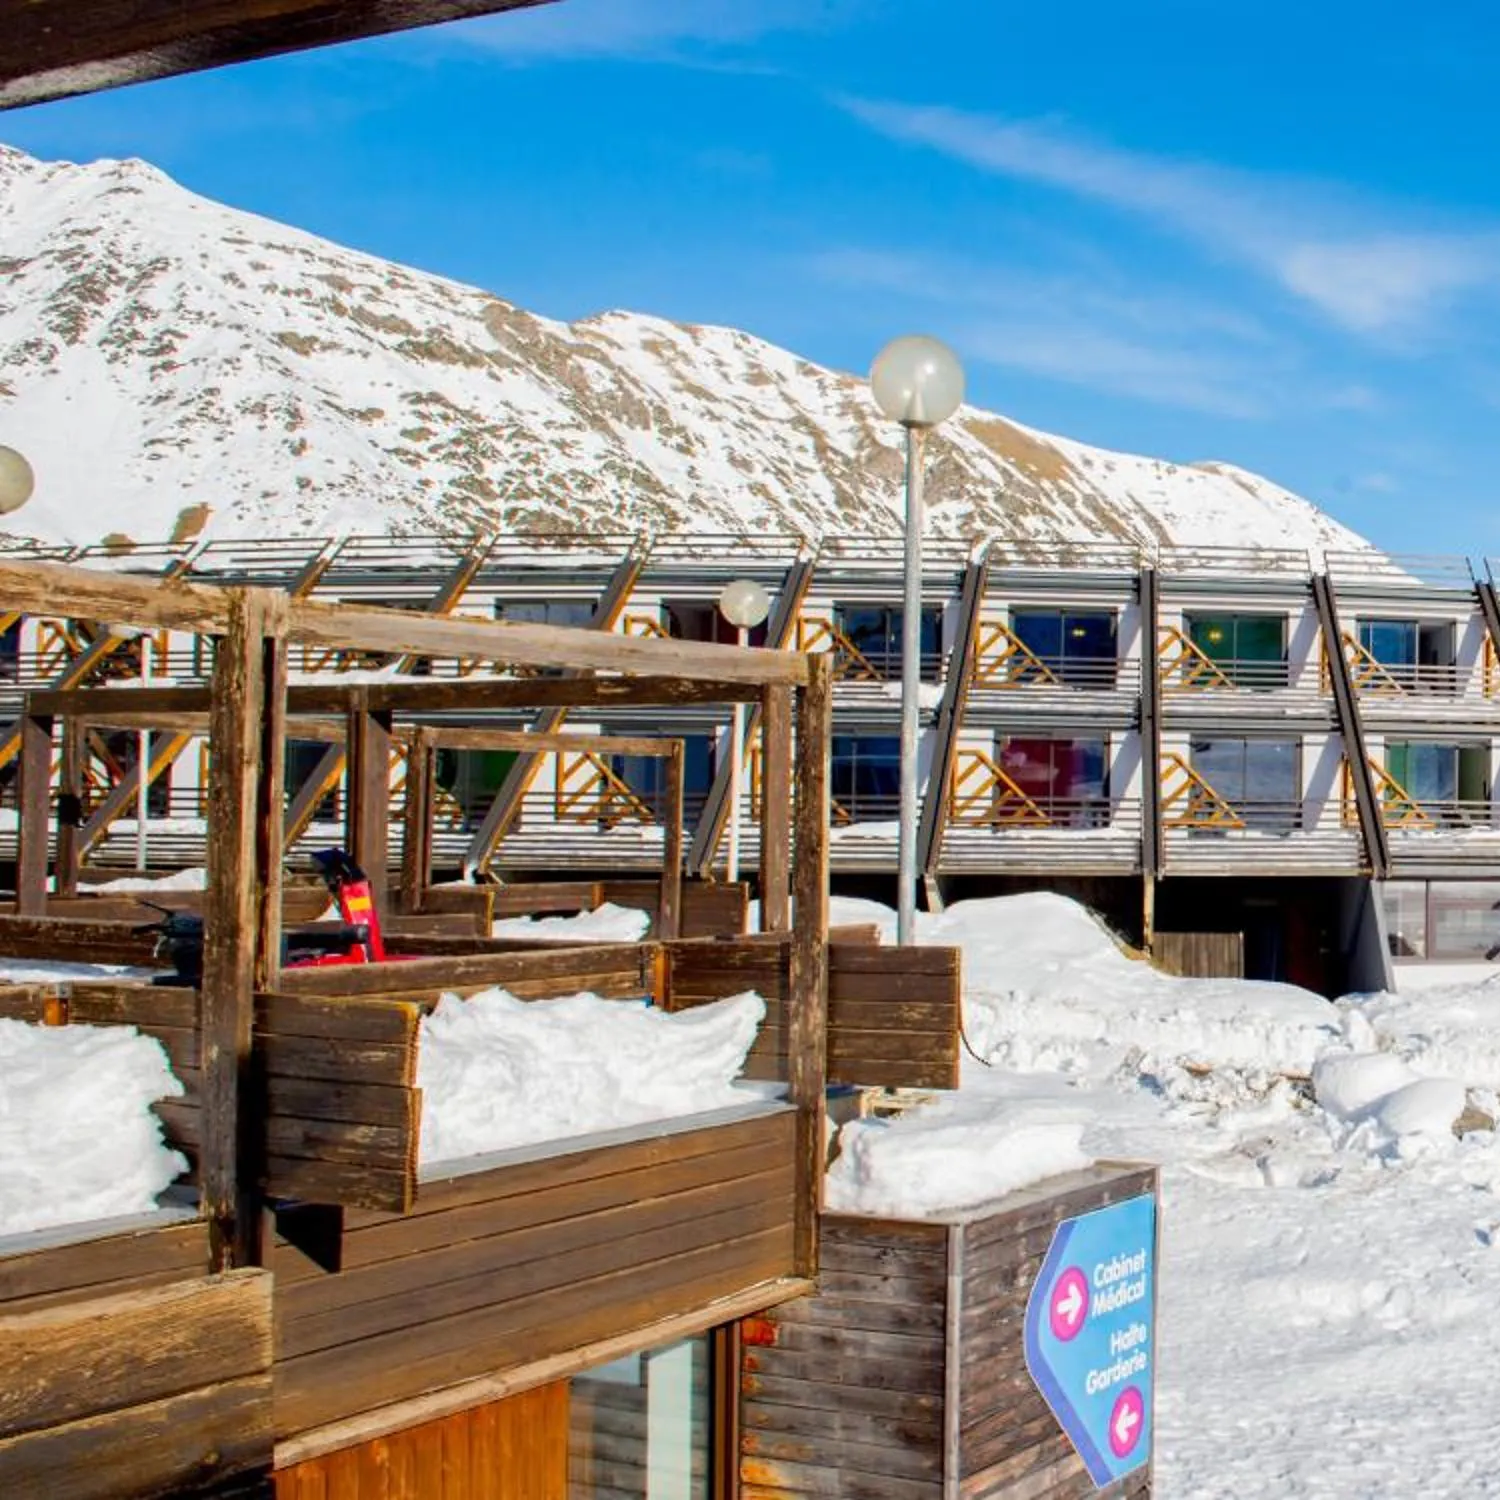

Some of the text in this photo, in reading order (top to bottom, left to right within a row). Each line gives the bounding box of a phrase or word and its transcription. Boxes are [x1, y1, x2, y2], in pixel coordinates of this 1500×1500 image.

[1093, 1248, 1146, 1289] Cabinet
[1111, 1323, 1147, 1357] Halte
[1086, 1348, 1147, 1395] Garderie
